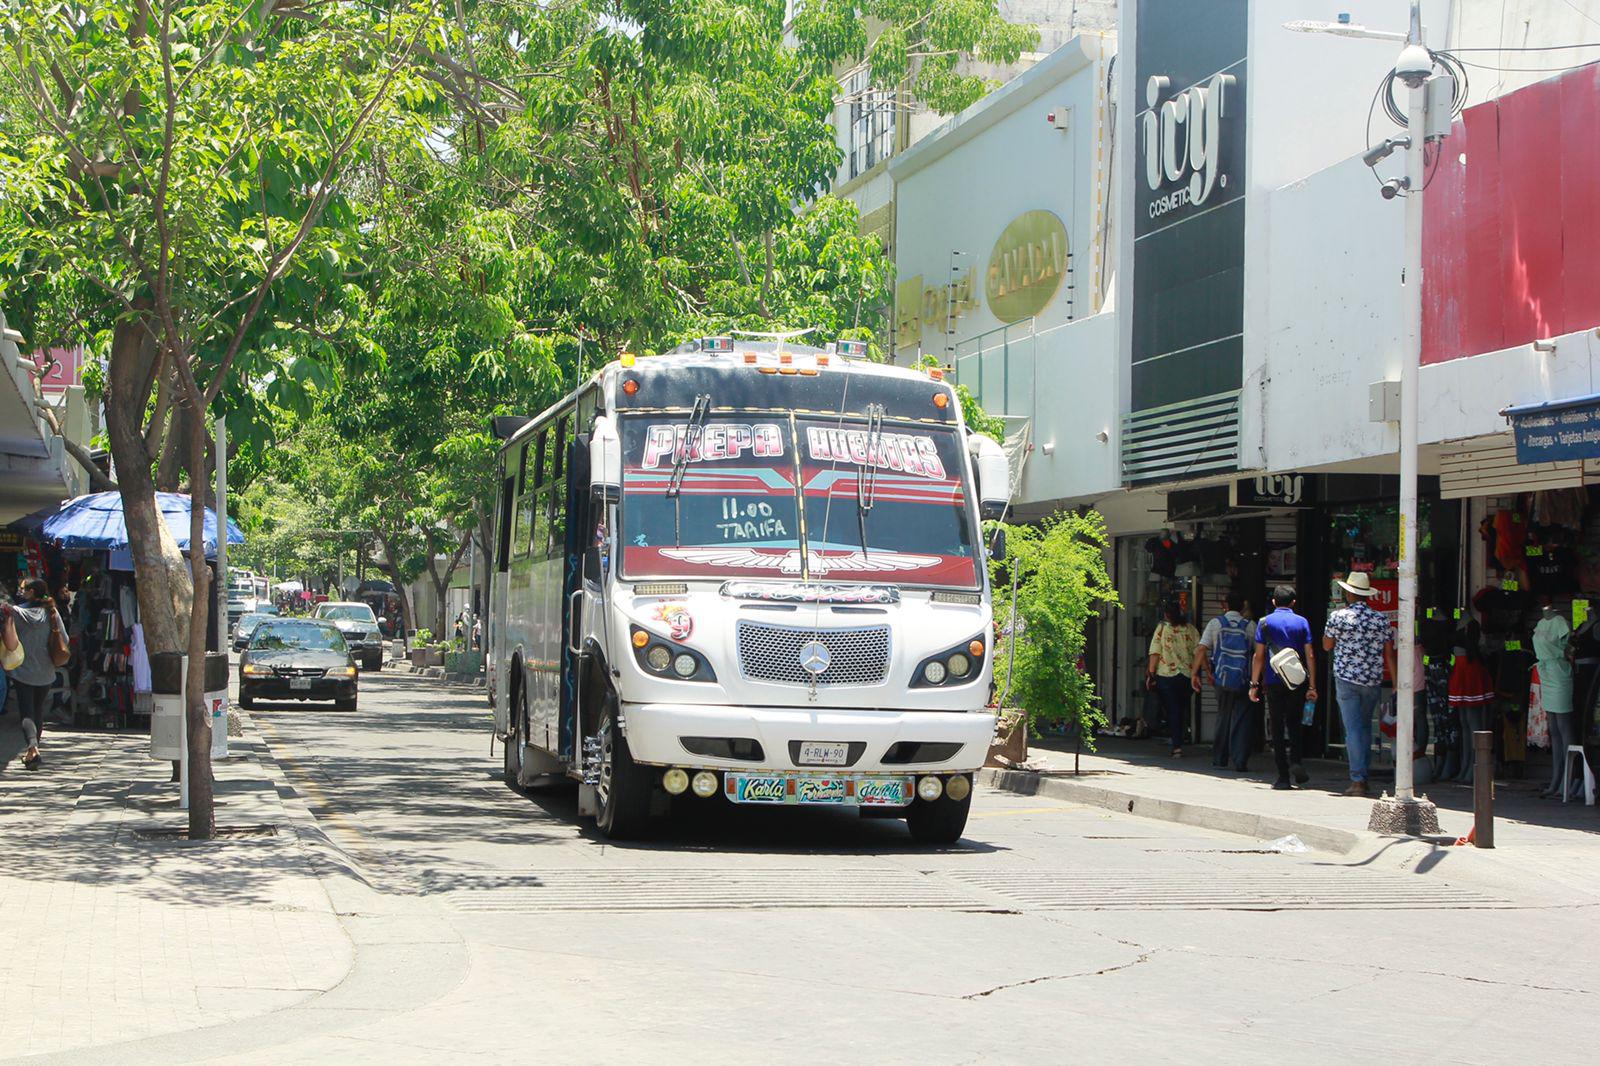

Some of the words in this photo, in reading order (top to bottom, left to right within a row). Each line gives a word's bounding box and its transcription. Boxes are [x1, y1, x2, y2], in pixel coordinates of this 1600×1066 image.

[1149, 186, 1191, 219] COSMETIC
[1527, 434, 1554, 449] Recargas
[1558, 431, 1582, 447] Tarjetas
[642, 424, 784, 469] PREPA
[807, 427, 946, 481] HUERTAS
[722, 497, 772, 519] 11.00
[716, 518, 787, 539] TARIFA
[744, 778, 784, 799] Karla
